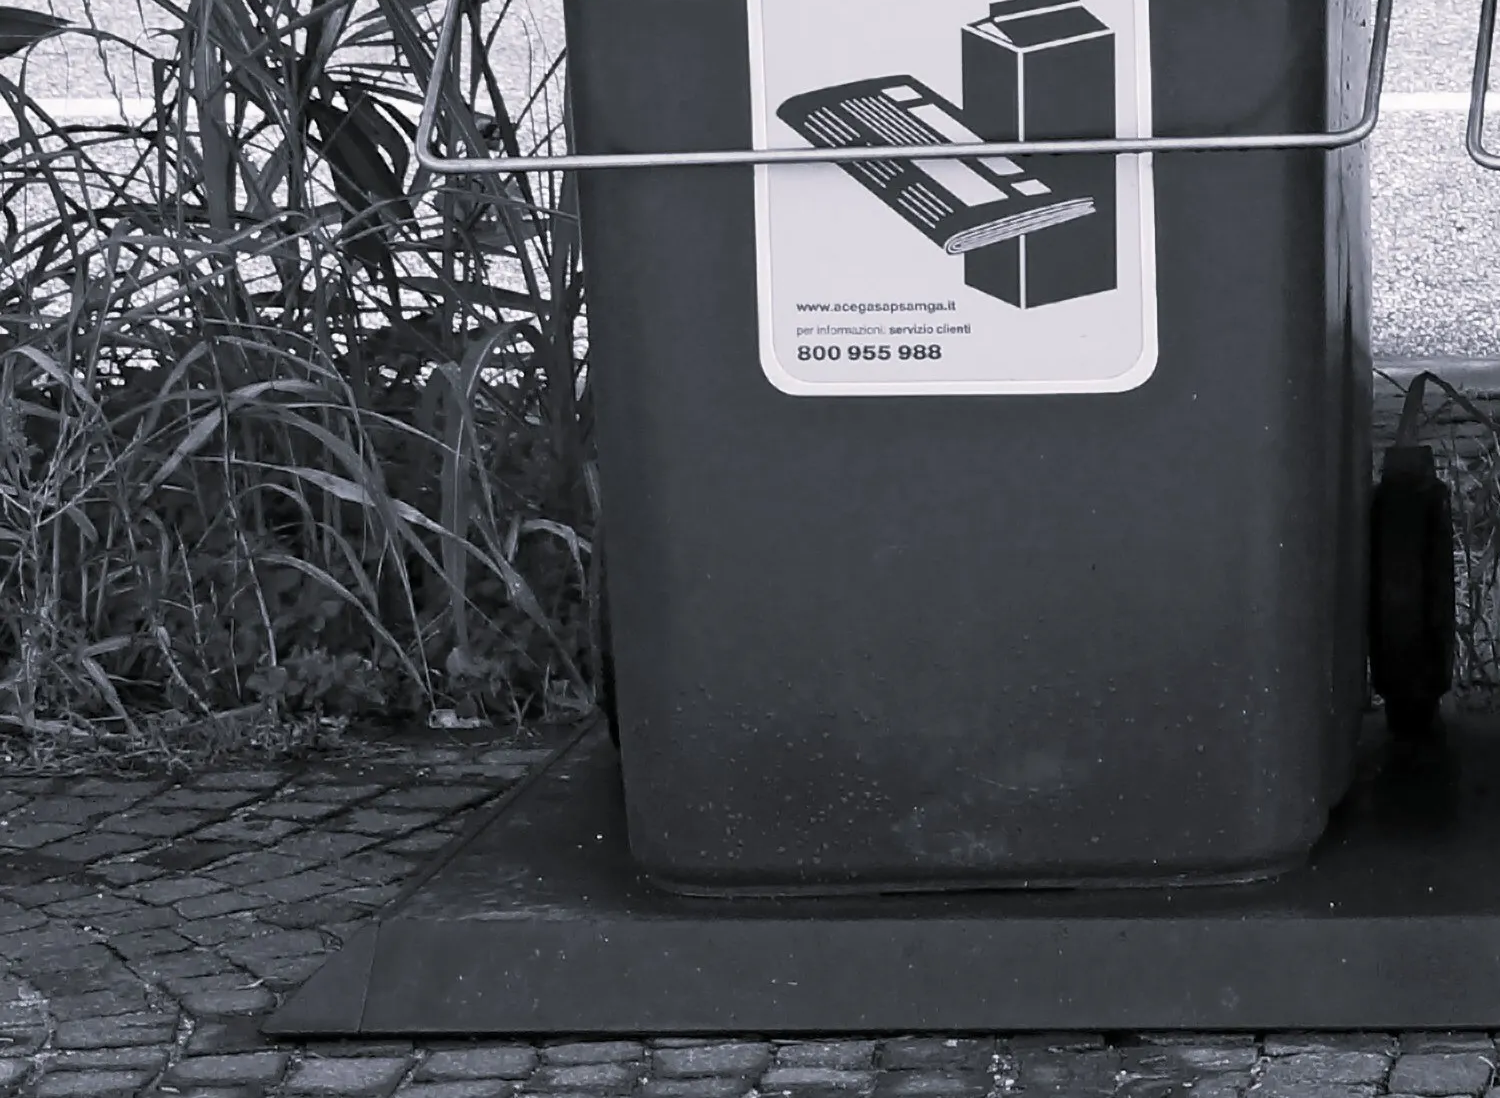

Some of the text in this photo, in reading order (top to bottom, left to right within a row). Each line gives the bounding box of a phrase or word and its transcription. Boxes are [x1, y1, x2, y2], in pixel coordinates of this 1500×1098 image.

[796, 300, 956, 314] www.acegasapsamga.it
[796, 325, 813, 337] per
[889, 324, 933, 335] servizio
[937, 323, 971, 334] clienti
[798, 344, 942, 361] 800 955 988
